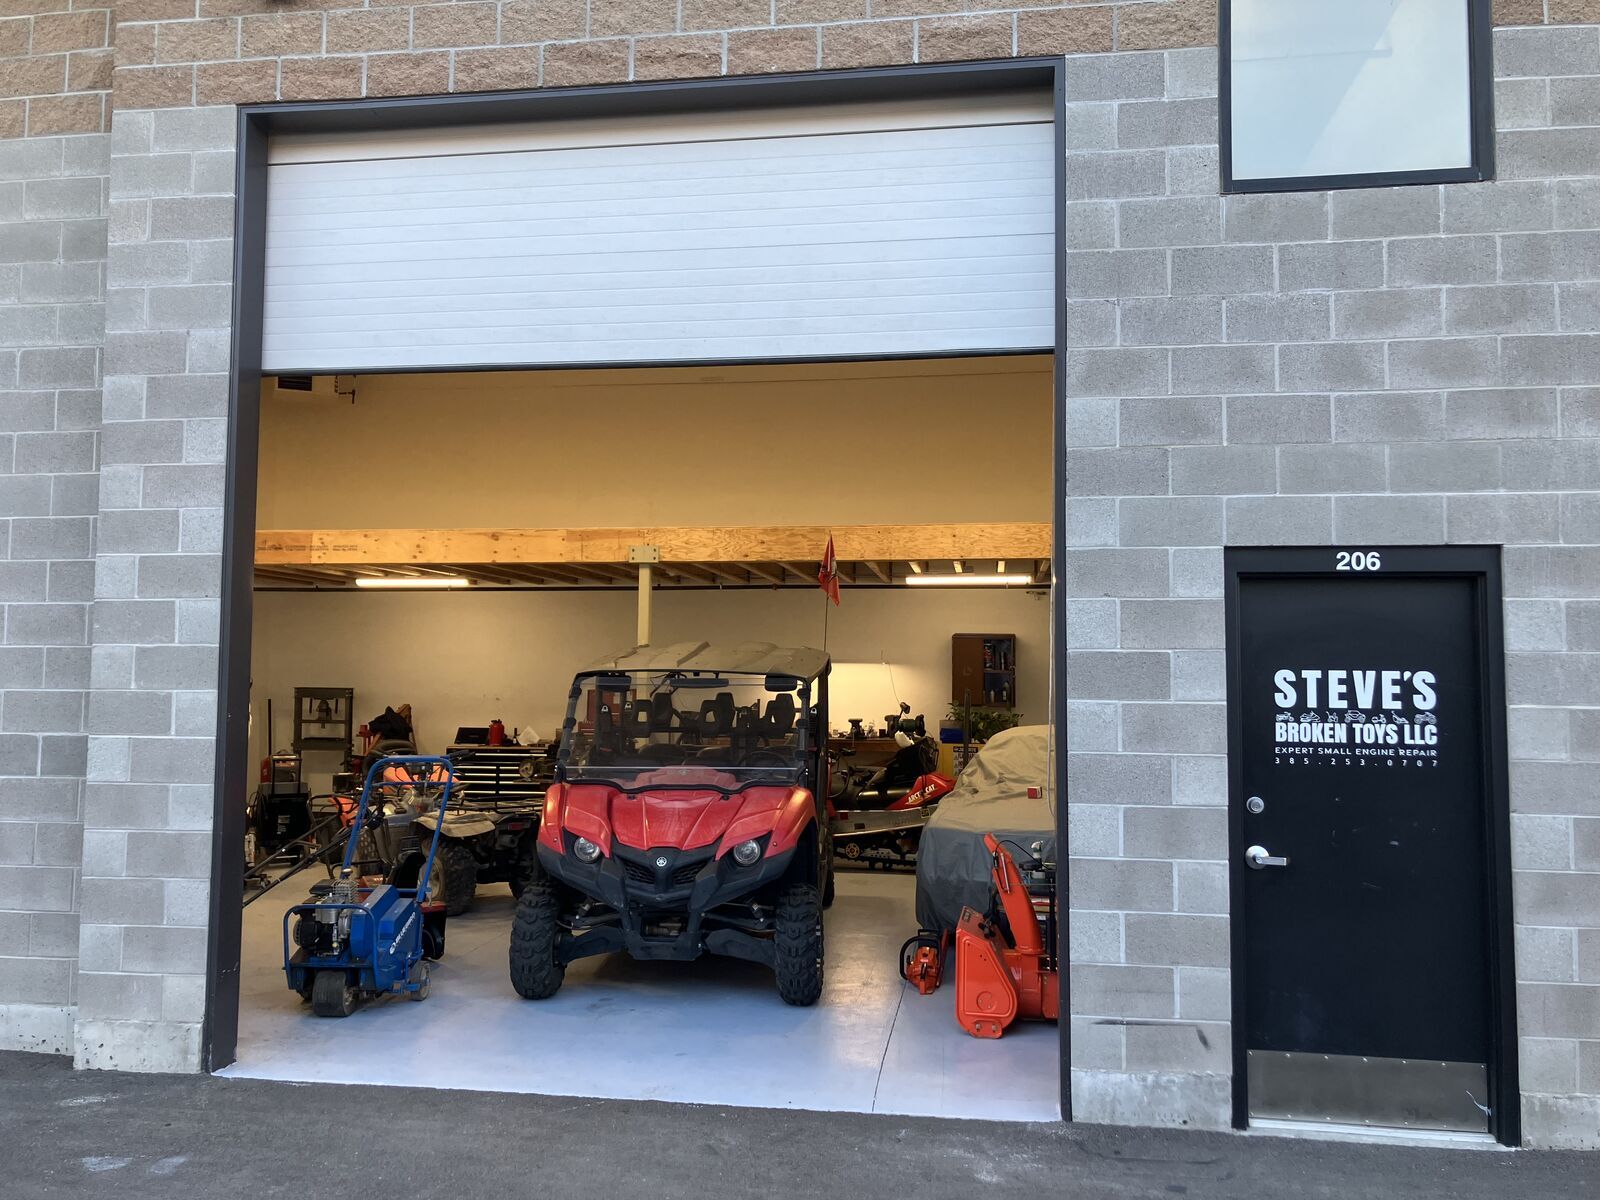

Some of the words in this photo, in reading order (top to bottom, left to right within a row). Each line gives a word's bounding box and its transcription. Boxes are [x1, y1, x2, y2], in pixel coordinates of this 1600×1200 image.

[1335, 551, 1381, 571] 206
[1273, 669, 1437, 710] STEVE'S
[1275, 722, 1347, 743] BROKEN
[1353, 723, 1398, 744] TOYS
[1403, 724, 1438, 745] LLC
[1318, 747, 1351, 755] SMALL
[1355, 748, 1395, 756] ENGINE
[1399, 749, 1437, 757] REPAIR
[925, 784, 935, 793] CAT
